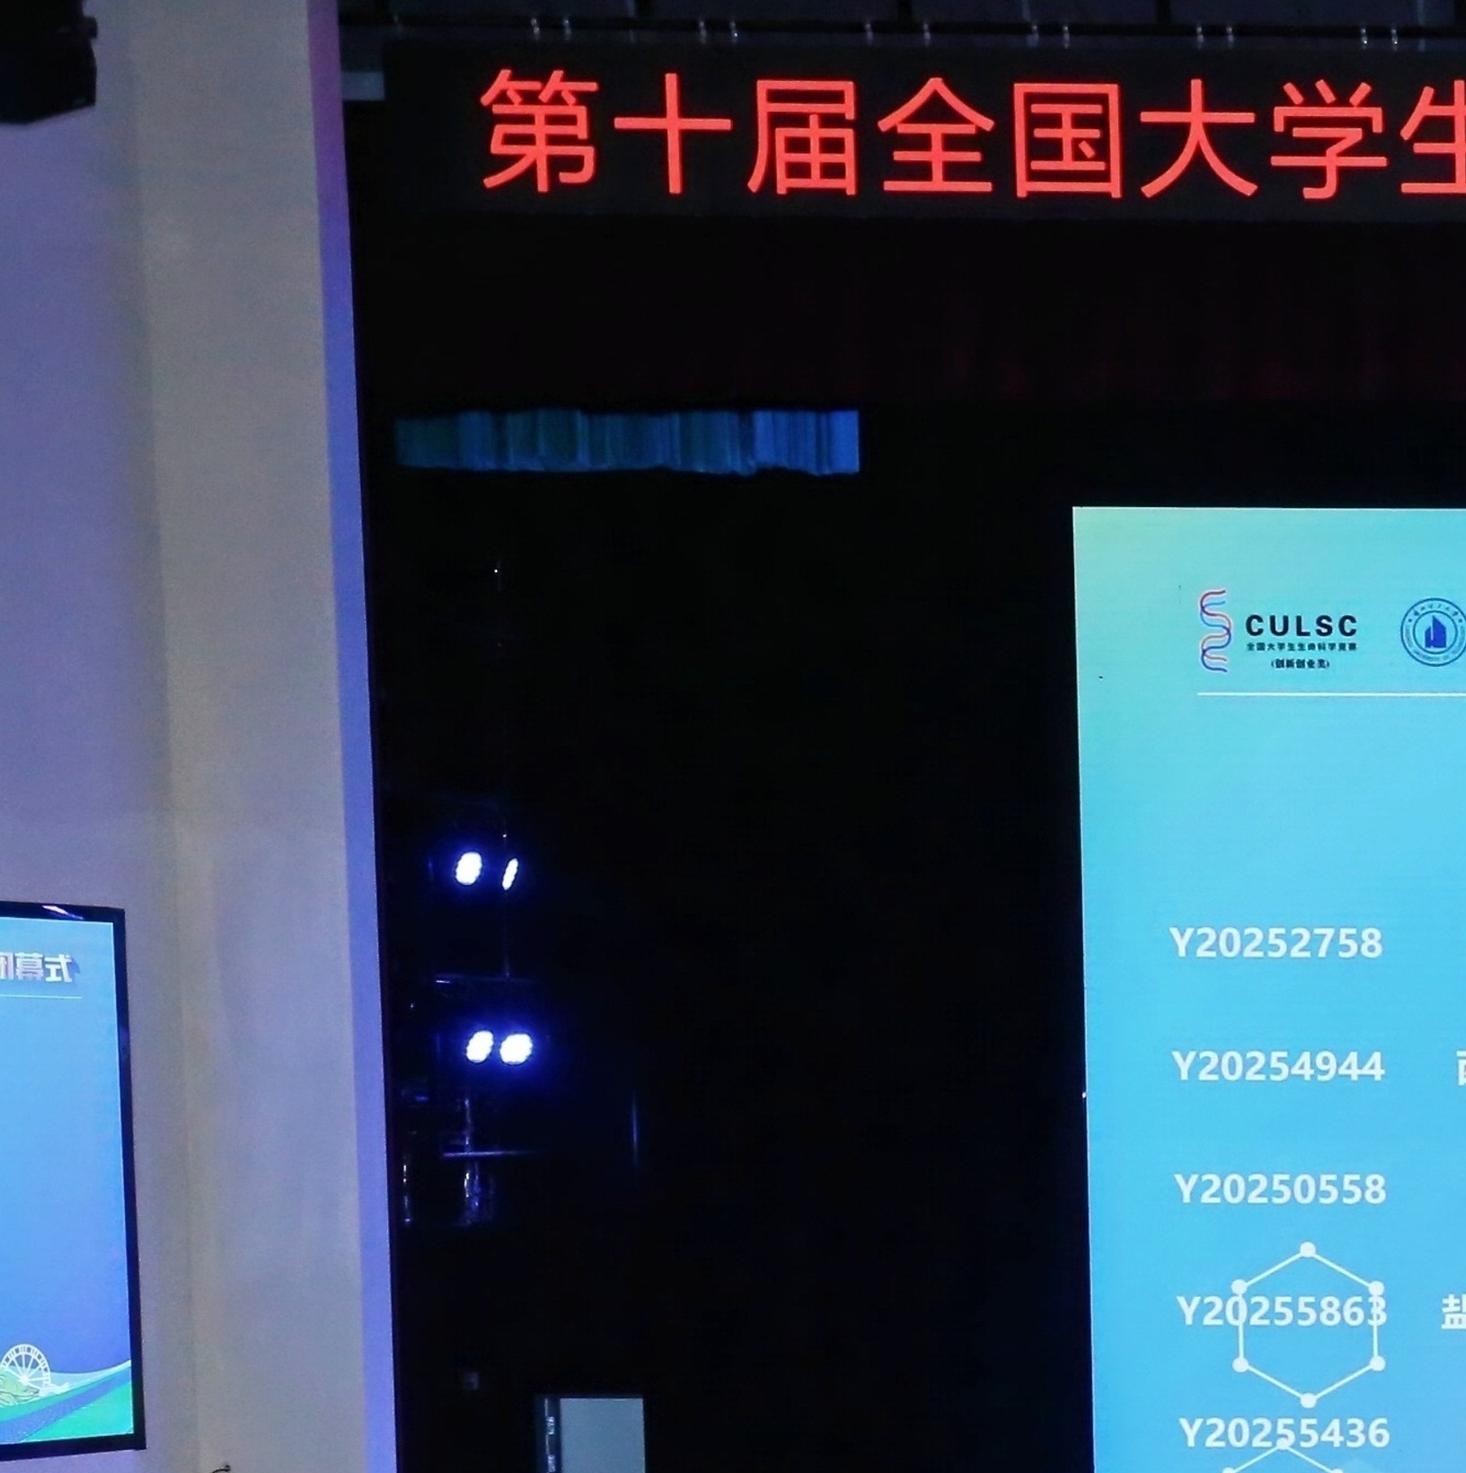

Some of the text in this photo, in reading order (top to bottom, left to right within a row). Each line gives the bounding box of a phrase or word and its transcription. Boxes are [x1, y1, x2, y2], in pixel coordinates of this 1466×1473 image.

[1245, 614, 1357, 637] CULSC
[1170, 927, 1382, 957] Y20252758
[1173, 1051, 1385, 1081] Y20254944
[1175, 1174, 1386, 1204] Y20250558
[1177, 1297, 1387, 1327] Y20255863
[1180, 1418, 1389, 1448] Y20255436
